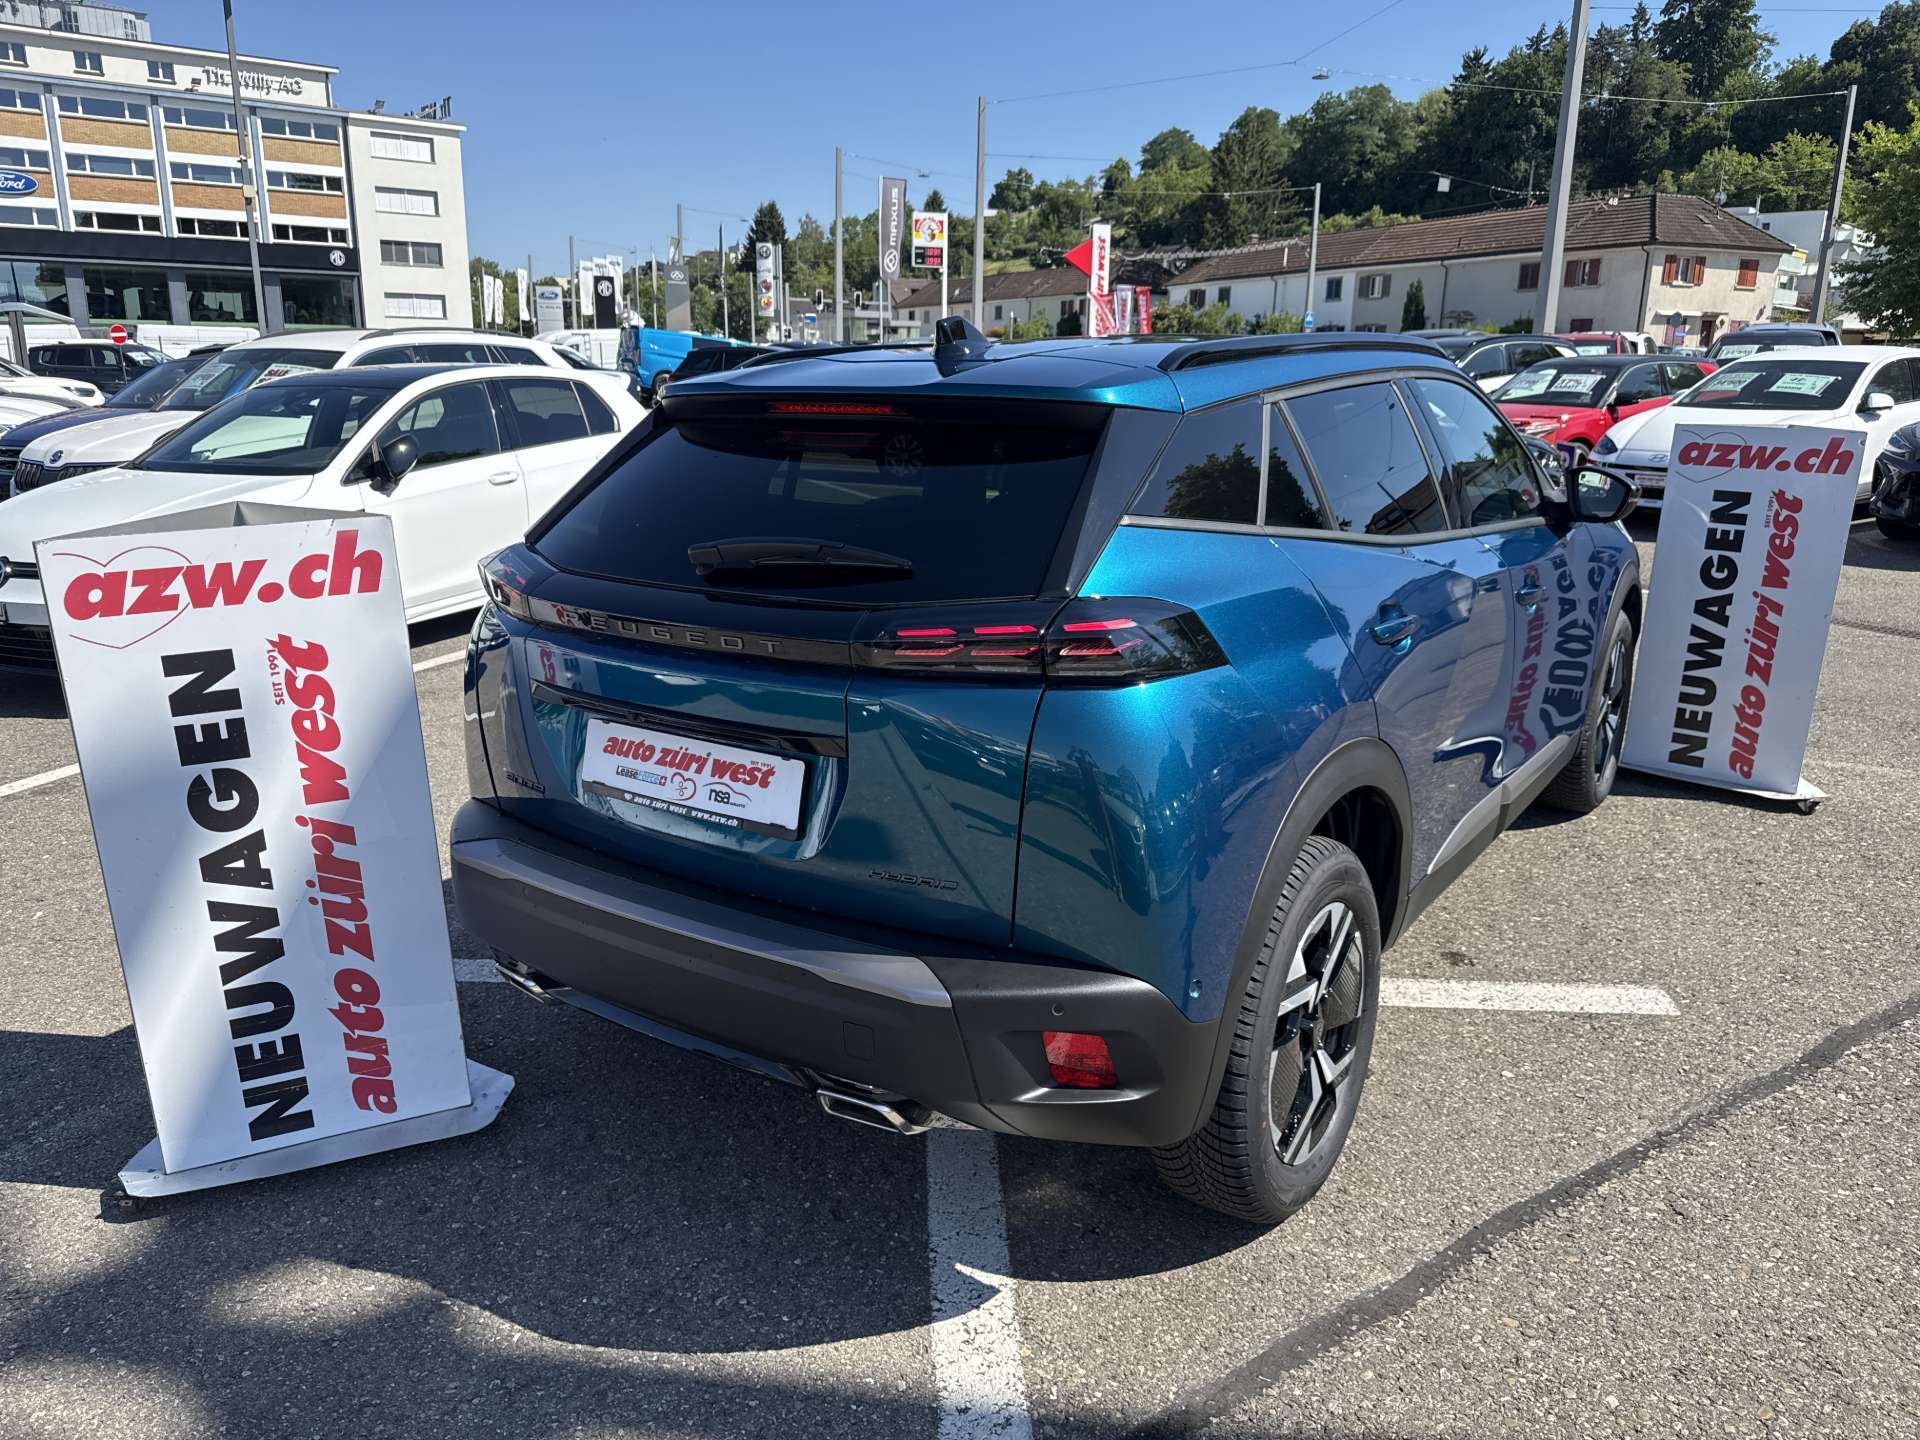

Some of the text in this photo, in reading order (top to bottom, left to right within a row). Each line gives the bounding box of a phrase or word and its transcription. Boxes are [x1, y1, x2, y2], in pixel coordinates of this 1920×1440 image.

[280, 75, 304, 94] AG
[890, 187, 898, 246] MAXUS
[598, 280, 612, 296] MG
[1677, 437, 1855, 475] azw.ch
[64, 529, 383, 622] azw.ch
[562, 608, 782, 655] PEUGEOT
[1668, 489, 1752, 768] NEUWAGEN
[1729, 488, 1803, 780] auto züri west
[266, 649, 286, 706] SEIT 1991
[602, 736, 776, 788] auto züri west
[634, 796, 738, 828] auto züri west www.azw.ch
[708, 788, 730, 804] nsa
[160, 647, 315, 1142] NEUWAGEN
[264, 632, 398, 1114] auto züri west
